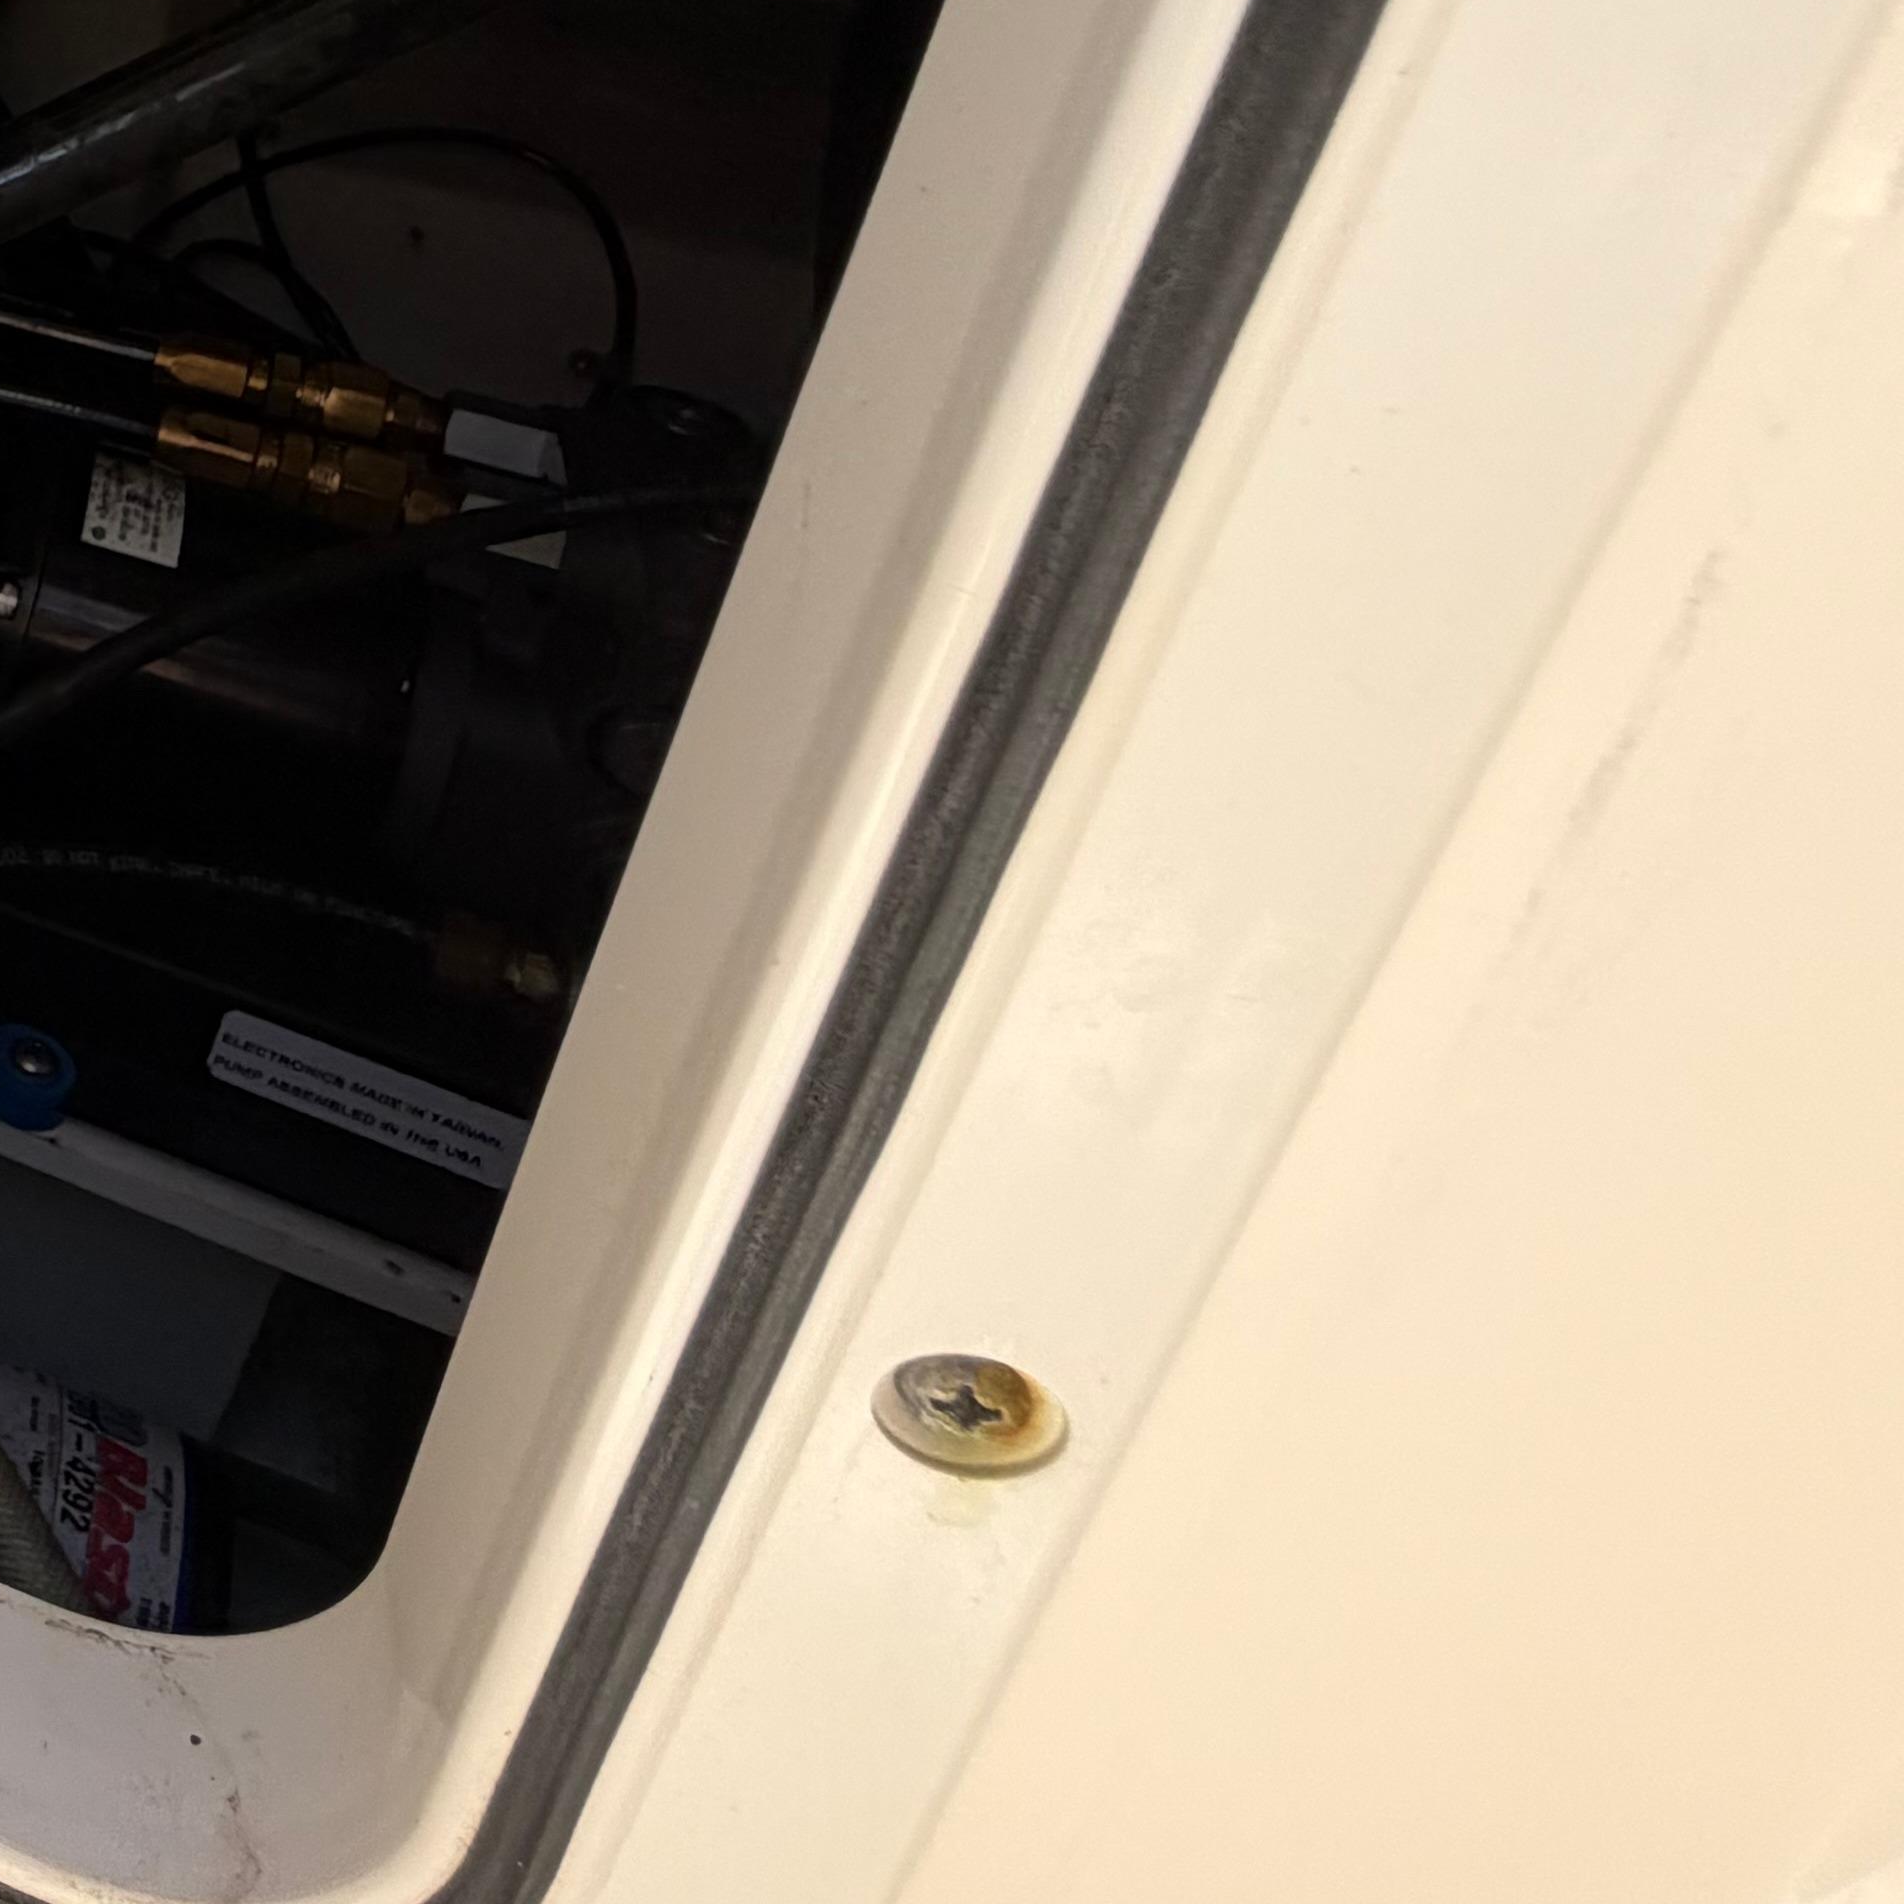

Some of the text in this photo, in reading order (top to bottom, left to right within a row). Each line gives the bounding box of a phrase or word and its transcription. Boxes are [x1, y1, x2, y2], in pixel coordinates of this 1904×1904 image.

[213, 1054, 264, 1081] PUMP
[268, 1076, 376, 1126] ASSEMBLED
[221, 1032, 345, 1090] ELECTRONICS
